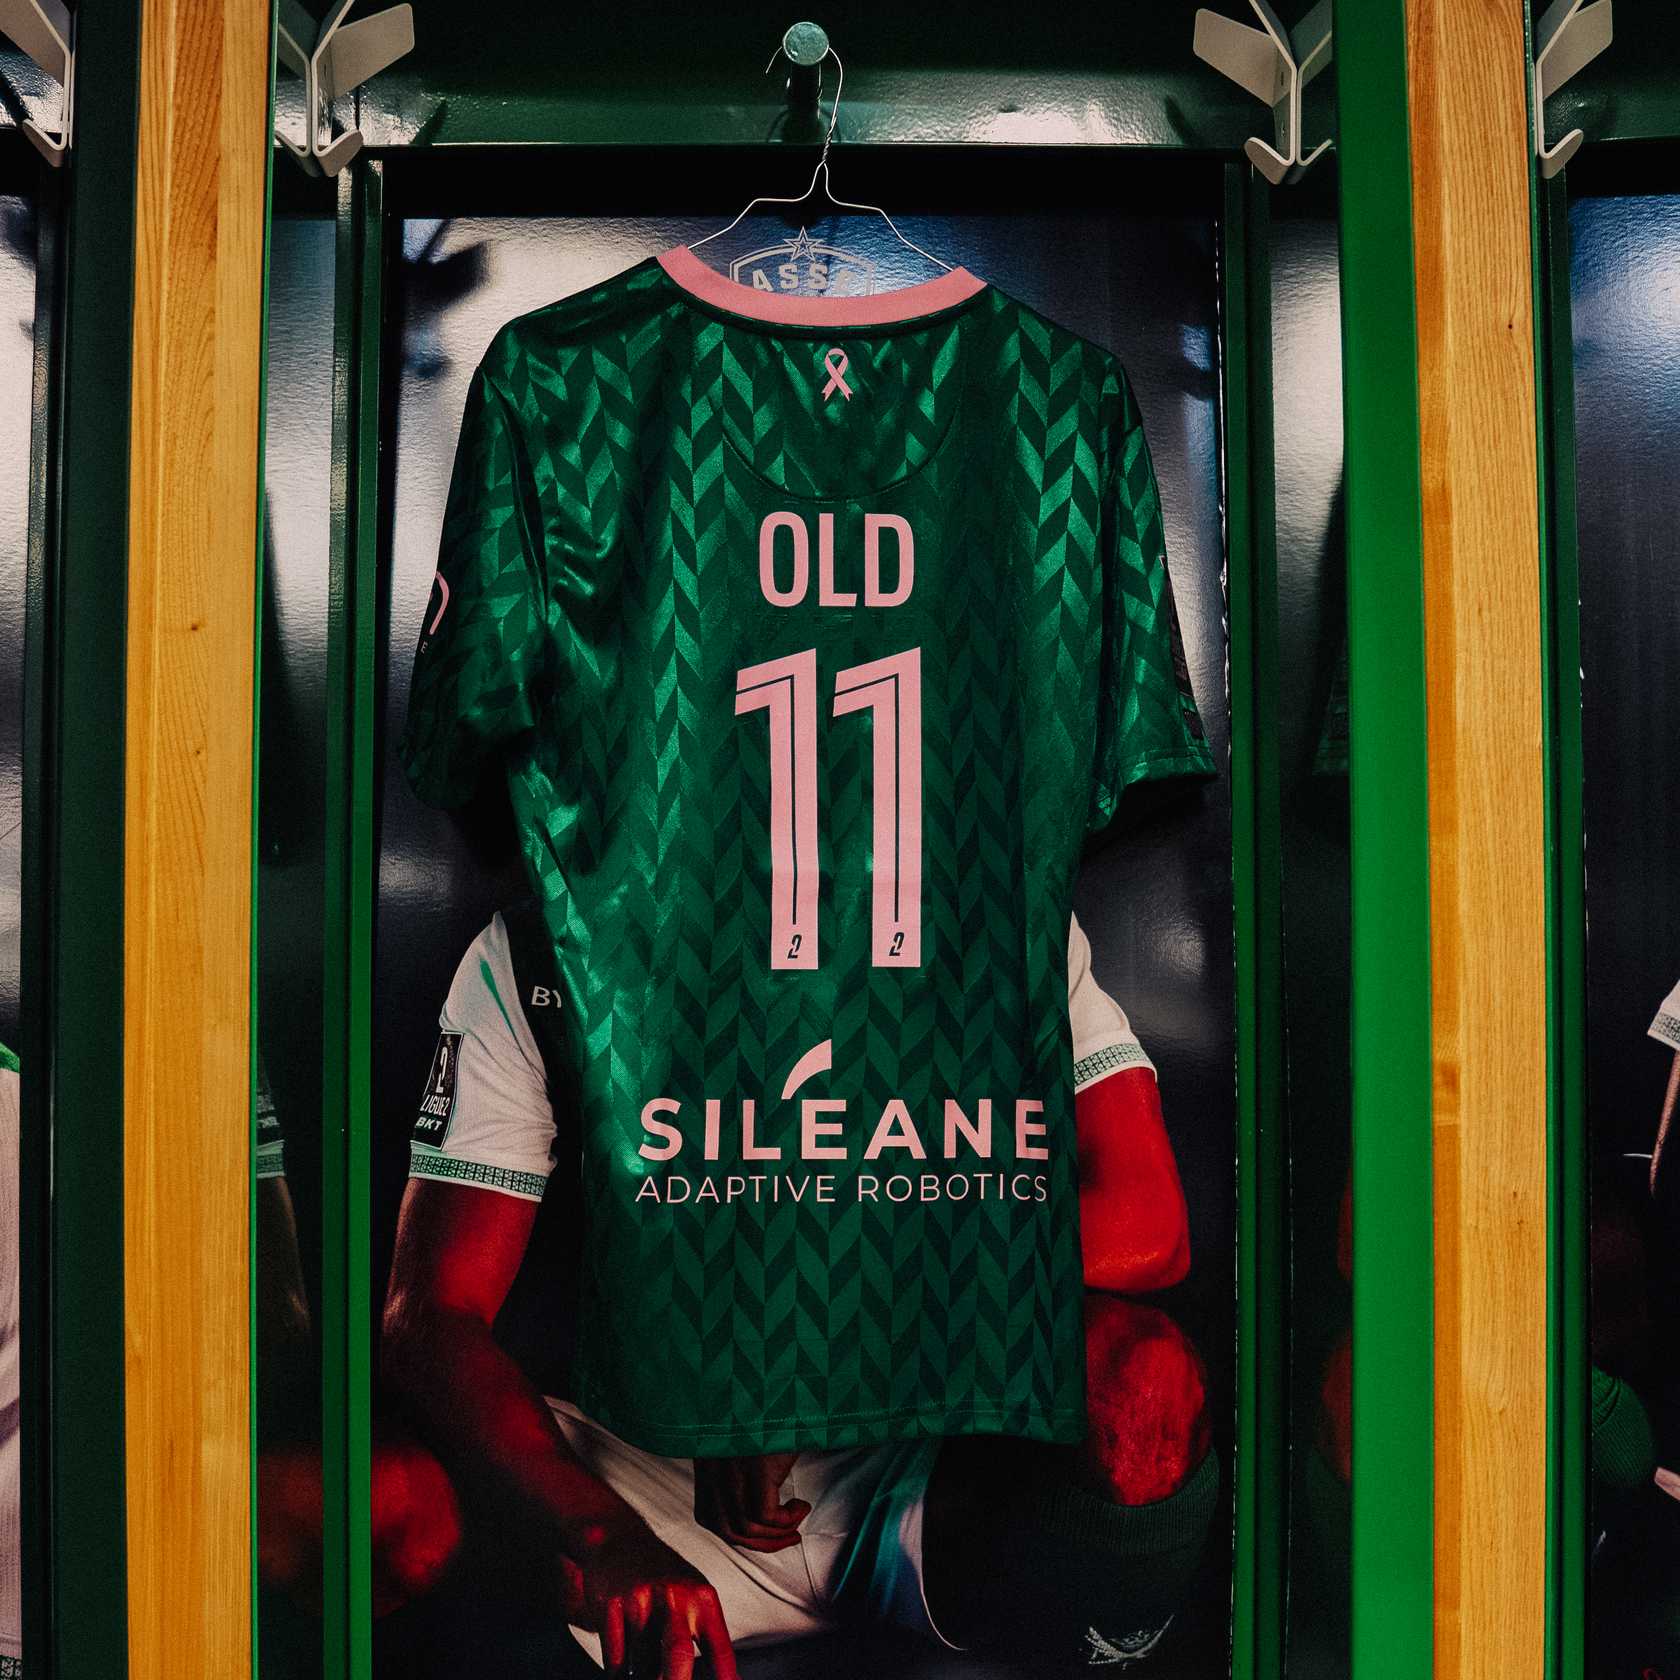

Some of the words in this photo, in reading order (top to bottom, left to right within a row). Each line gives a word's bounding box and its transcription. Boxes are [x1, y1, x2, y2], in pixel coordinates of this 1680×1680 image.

[759, 511, 915, 607] OLD
[735, 646, 922, 970] 11
[787, 934, 803, 959] 2
[889, 932, 905, 957] 2
[415, 1117, 443, 1131] BKT
[635, 1175, 836, 1204] ADAPTIVE
[858, 1174, 1047, 1203] ROBOTICS
